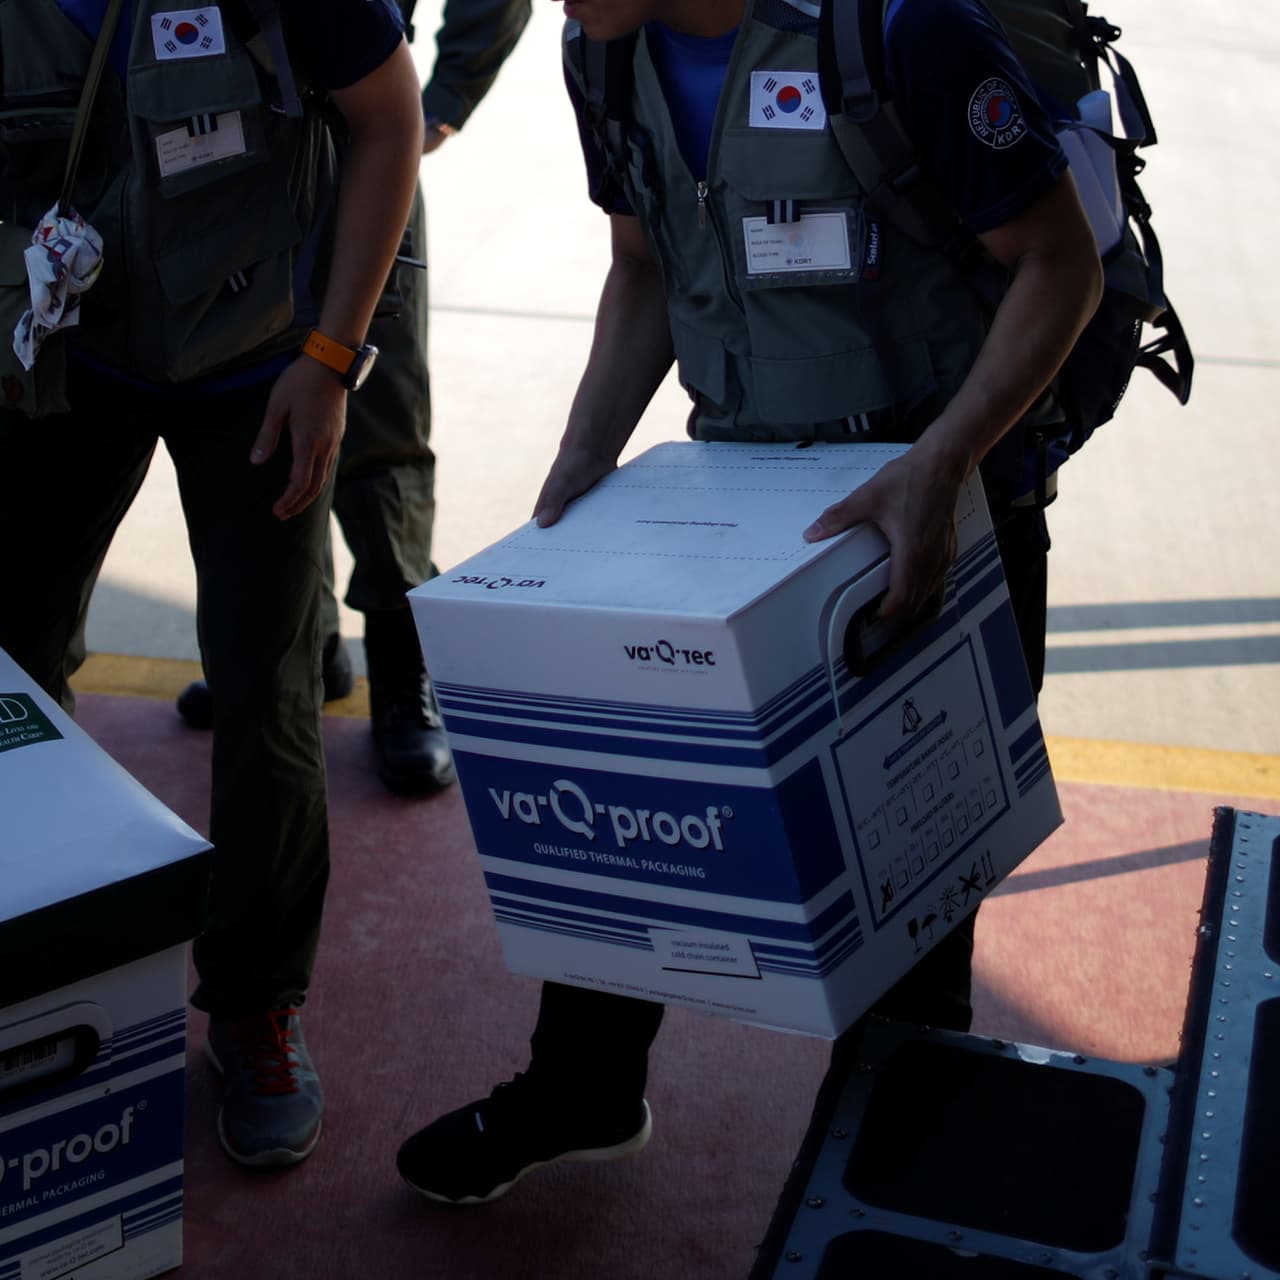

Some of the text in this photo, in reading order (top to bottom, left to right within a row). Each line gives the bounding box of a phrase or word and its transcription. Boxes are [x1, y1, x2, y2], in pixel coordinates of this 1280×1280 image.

[534, 842, 706, 878] QUALIFIED THERMAL PACKAGING
[42, 1169, 107, 1202] PACKAGING
